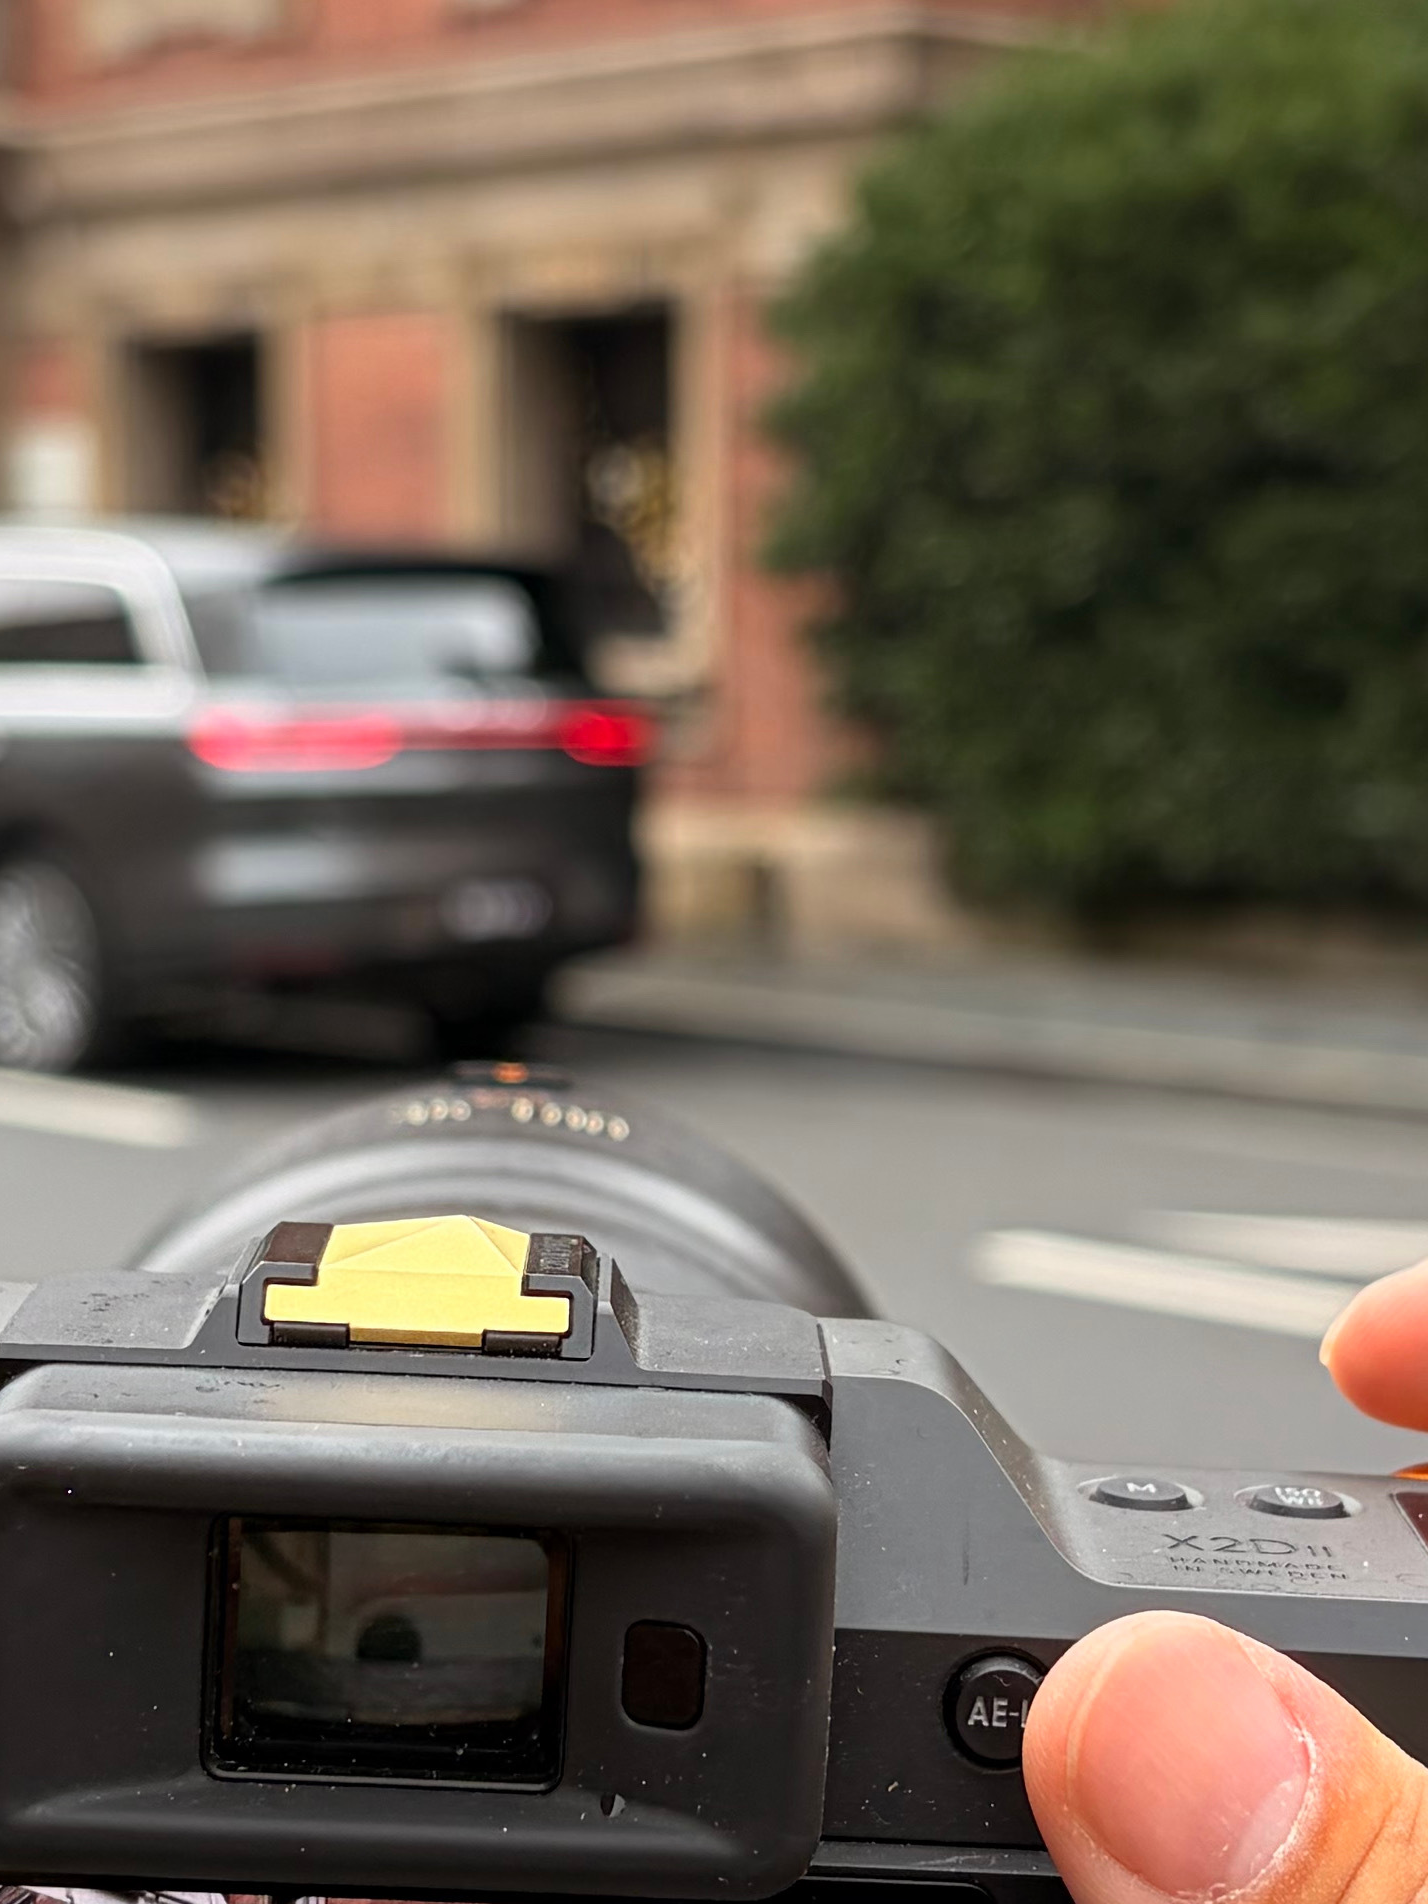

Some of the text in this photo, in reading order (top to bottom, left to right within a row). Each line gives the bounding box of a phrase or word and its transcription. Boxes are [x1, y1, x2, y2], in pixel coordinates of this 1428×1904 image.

[1125, 1481, 1157, 1494] M
[1161, 1533, 1299, 1555] X2D
[1169, 1556, 1339, 1571] HANDMADE
